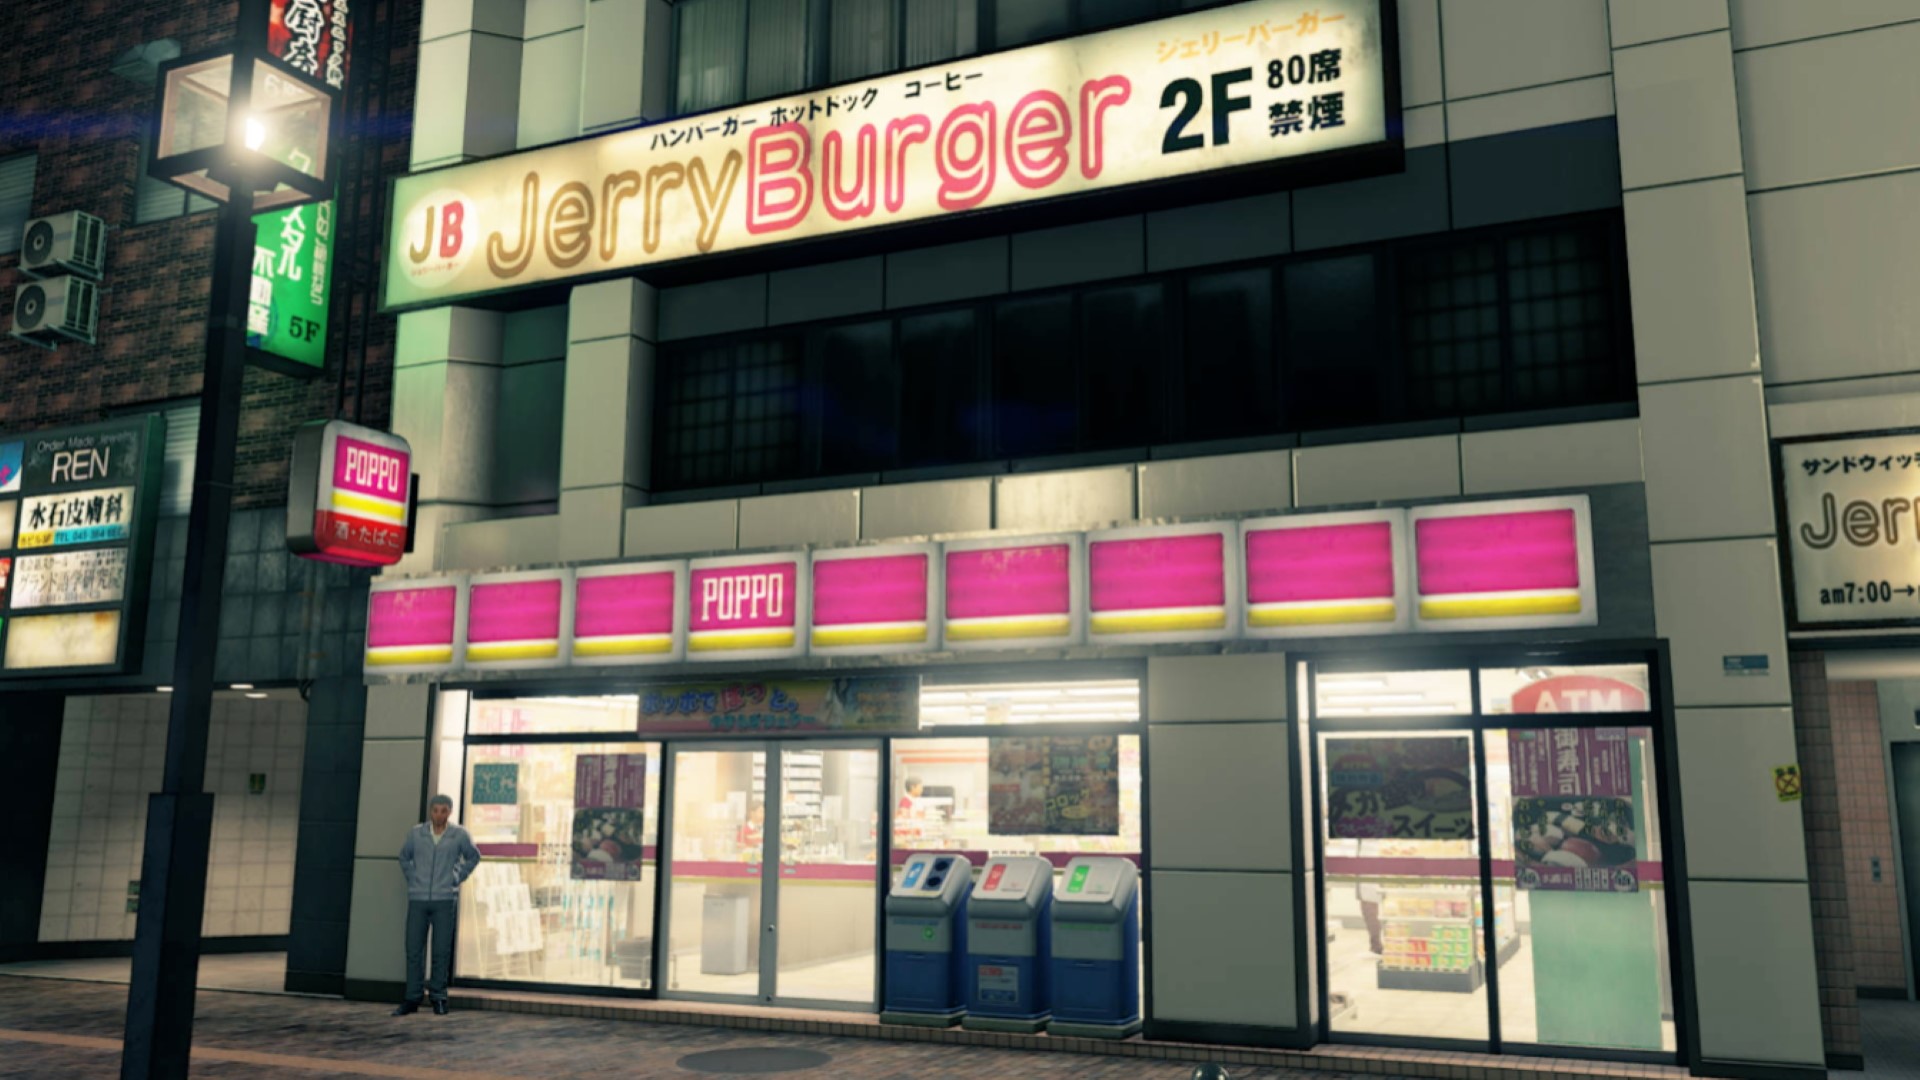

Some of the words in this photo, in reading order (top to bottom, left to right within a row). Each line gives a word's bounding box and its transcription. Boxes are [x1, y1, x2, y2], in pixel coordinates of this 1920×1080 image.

[1157, 9, 1346, 63] ジェリーバーガー
[1267, 48, 1342, 89] 80席
[650, 115, 757, 151] ハンバーガー
[904, 71, 983, 99] コーヒー
[1159, 66, 1253, 155] 2F
[1268, 91, 1345, 138] 禁煙
[289, 314, 321, 344] 5F
[51, 446, 110, 484] REN
[343, 446, 400, 493] POPPO
[1801, 492, 1920, 549] Jer
[702, 573, 783, 621] POPPO
[1535, 688, 1623, 714] ATM
